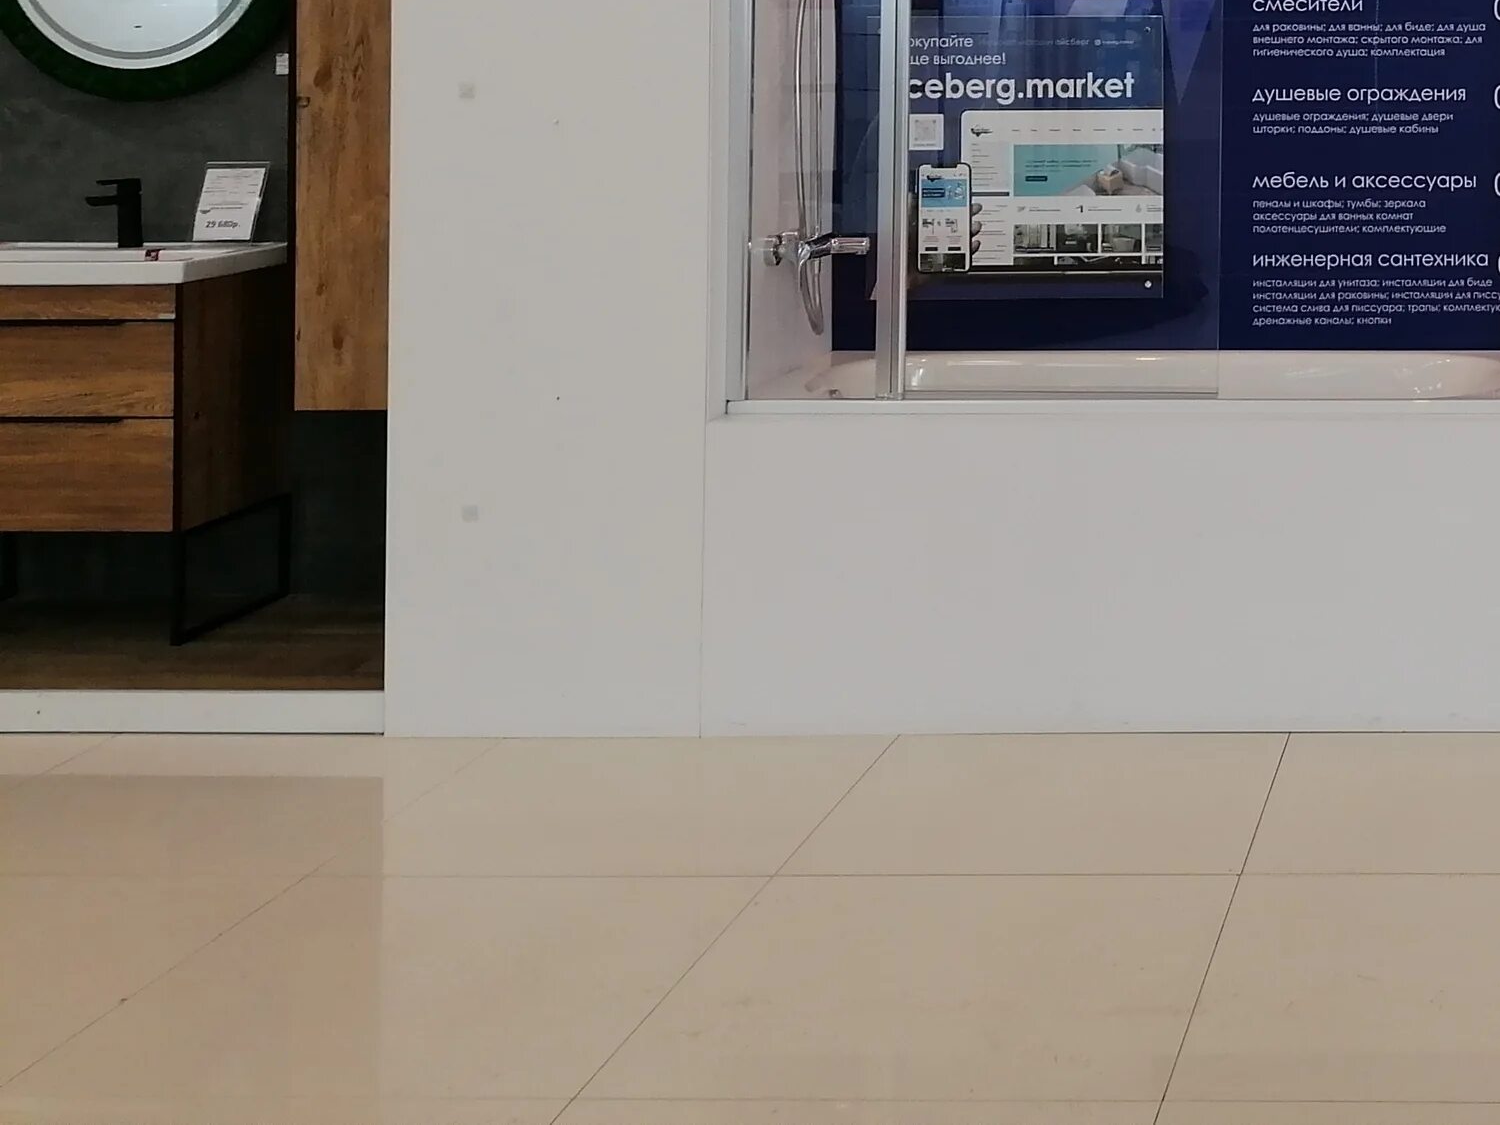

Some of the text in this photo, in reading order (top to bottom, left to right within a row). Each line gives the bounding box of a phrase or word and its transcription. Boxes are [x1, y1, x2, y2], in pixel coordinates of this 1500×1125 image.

[909, 34, 975, 51] окупайте
[909, 52, 1007, 67] ще выгоднее!
[909, 71, 1136, 106] ceberg.market
[1251, 88, 1466, 105] душевые ограждения
[1252, 171, 1329, 189] мебель
[1351, 175, 1477, 192] аксессуары
[1252, 253, 1373, 271] инженерная
